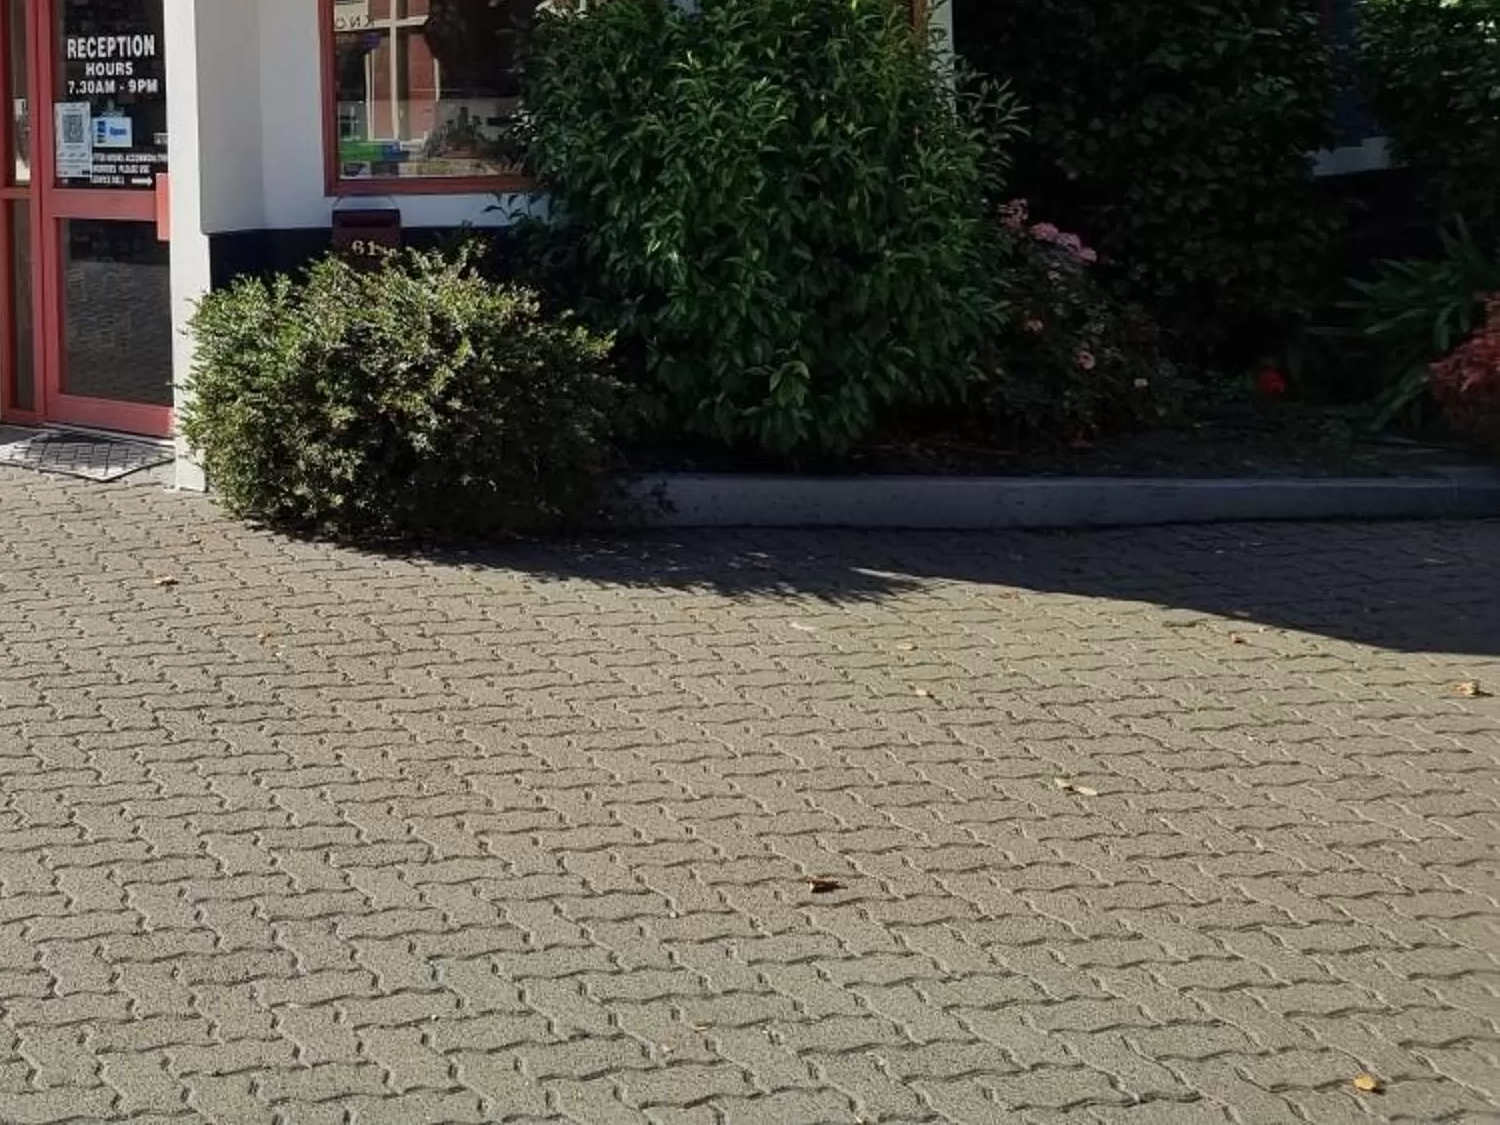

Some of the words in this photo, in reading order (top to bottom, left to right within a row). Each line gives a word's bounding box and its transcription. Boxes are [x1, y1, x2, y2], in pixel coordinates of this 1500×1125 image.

[67, 35, 155, 59] RECEPTION
[86, 62, 133, 75] HOURS
[68, 80, 115, 94] 7.30AM
[128, 79, 158, 93] 9PM
[352, 240, 376, 255] 61
